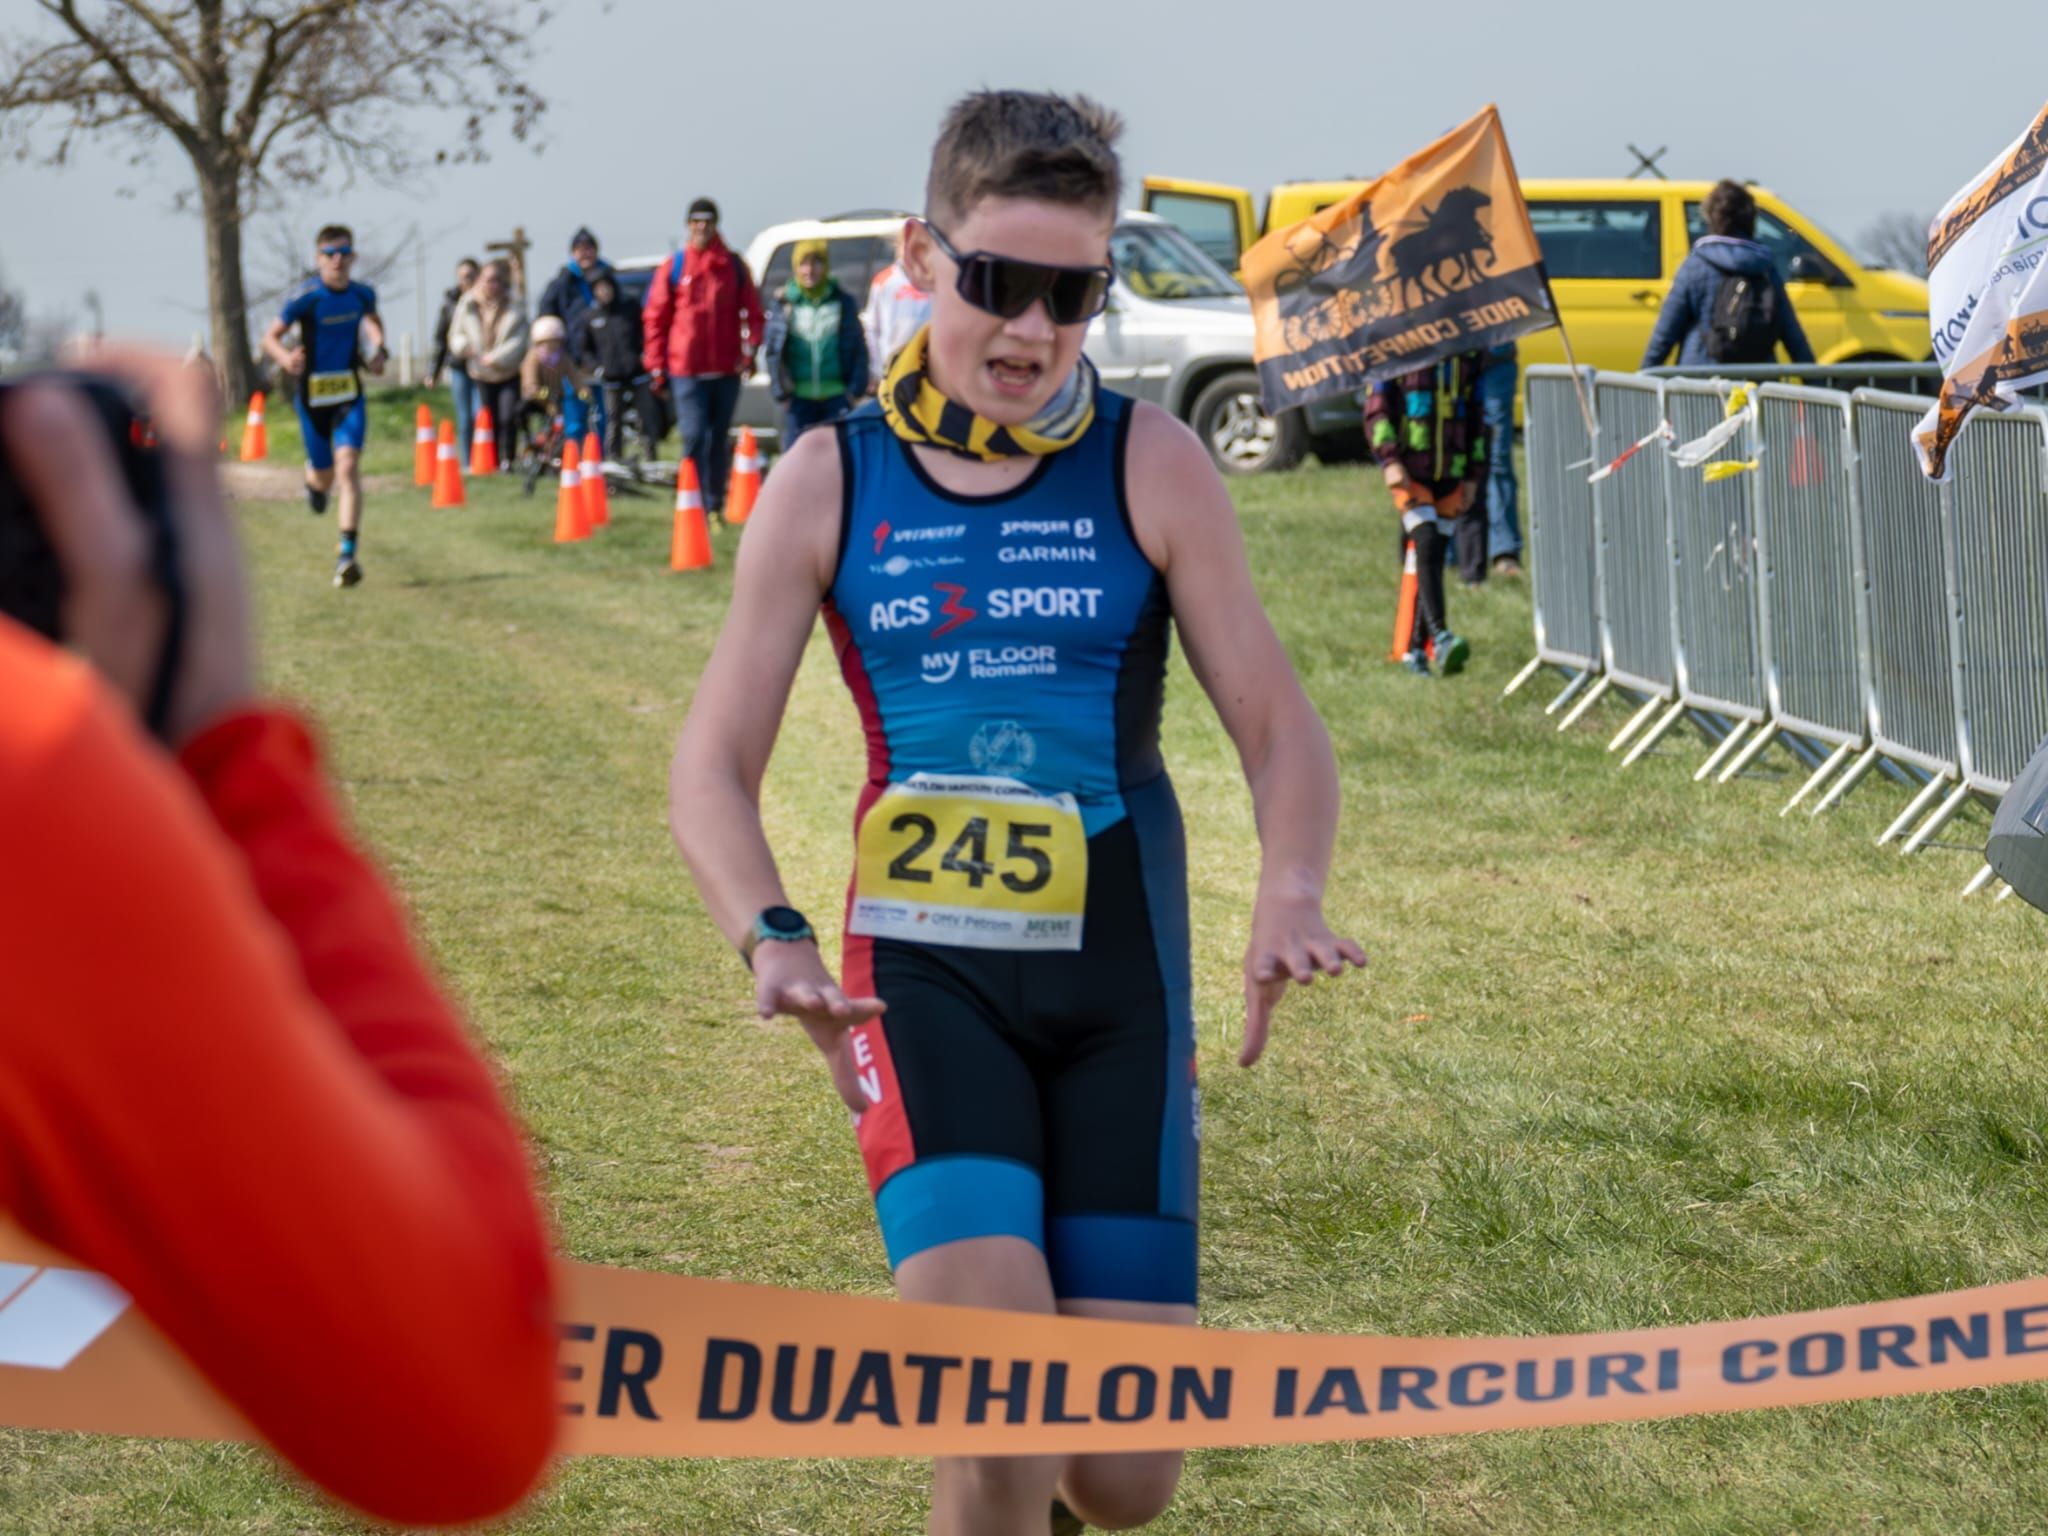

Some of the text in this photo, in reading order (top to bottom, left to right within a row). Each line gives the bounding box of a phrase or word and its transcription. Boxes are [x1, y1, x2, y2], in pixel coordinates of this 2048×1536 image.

[998, 546, 1097, 563] GARMIN
[870, 595, 931, 632] ACS
[987, 587, 1103, 619] SPORT
[968, 645, 1057, 665] FLOOR
[970, 661, 1058, 679] Romania
[888, 812, 1053, 894] 245
[697, 1336, 1233, 1427] DUATHLON
[1273, 1347, 1679, 1418] IARCURI
[1721, 1303, 2048, 1385] CORNE
